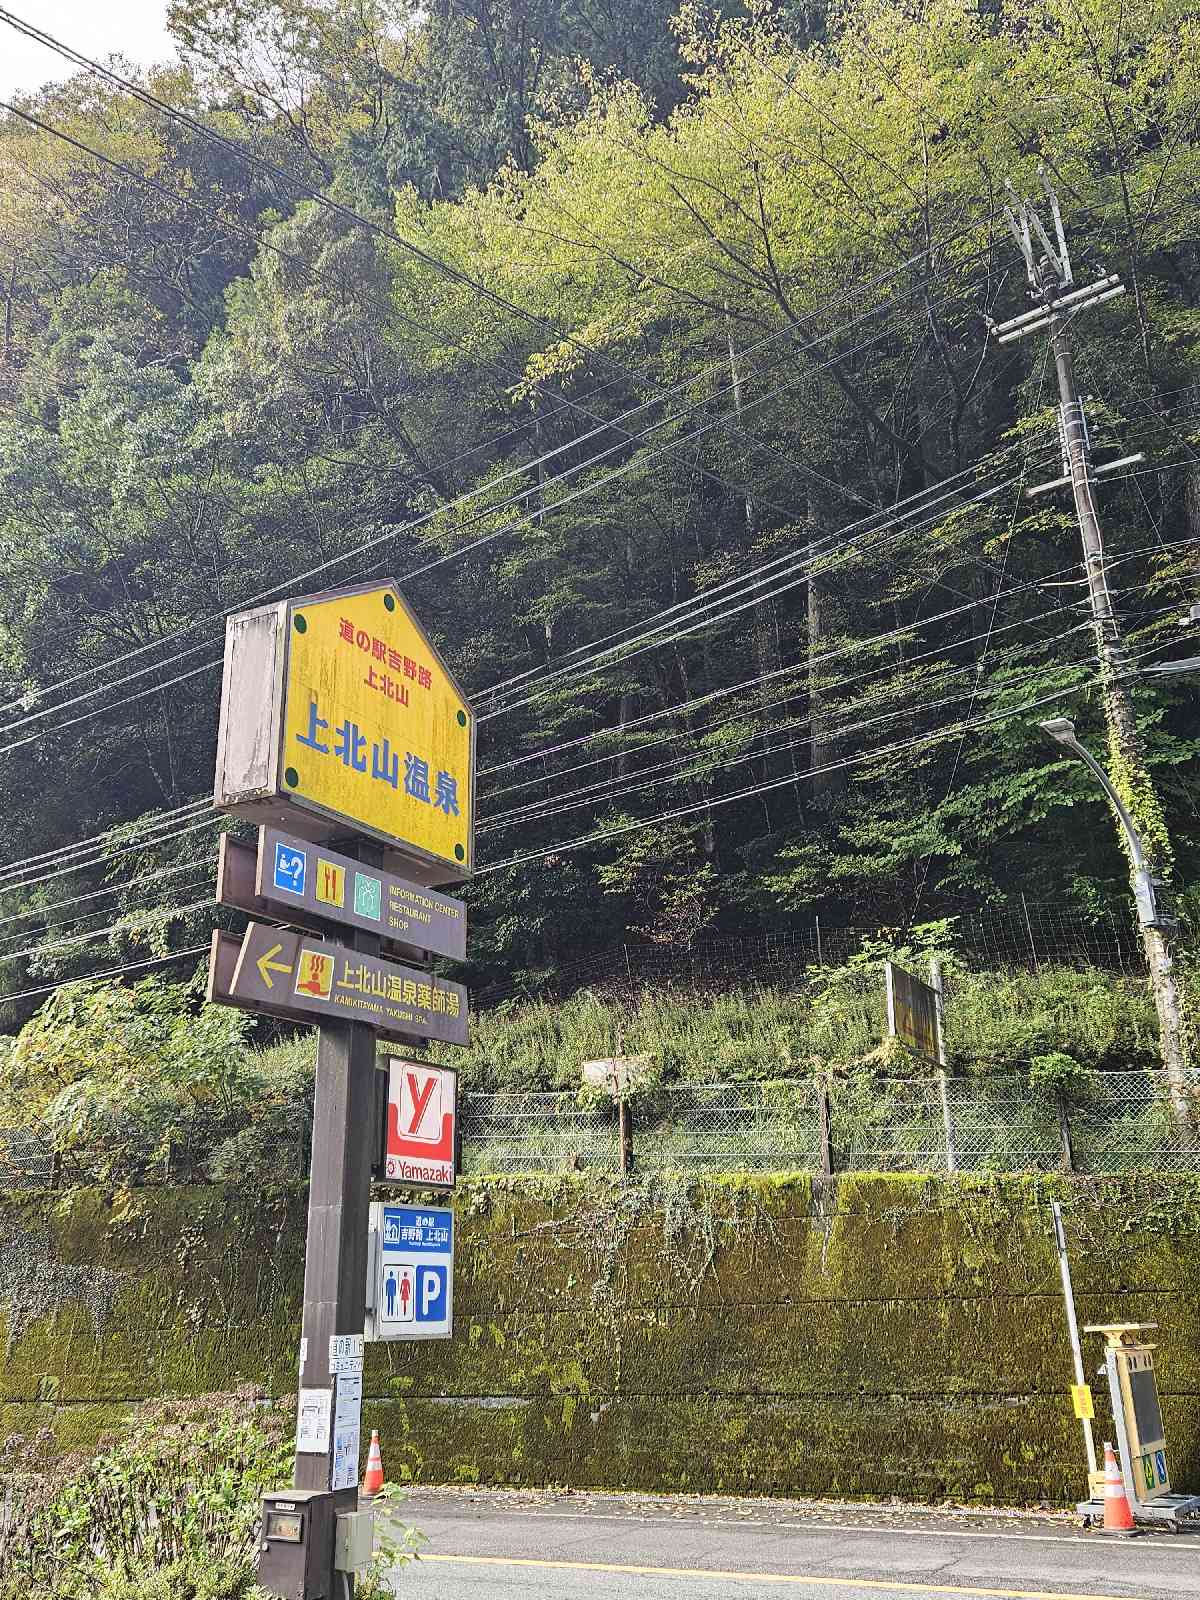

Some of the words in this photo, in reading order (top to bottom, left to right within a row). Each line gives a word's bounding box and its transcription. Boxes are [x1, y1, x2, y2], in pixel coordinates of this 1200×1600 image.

[339, 617, 432, 690] 道の駅吉野路
[364, 665, 409, 708] 上北山
[296, 702, 460, 817] 上北山温泉
[389, 885, 433, 909] INFORMATION
[434, 902, 460, 919] CENTER
[389, 900, 432, 924] RESTAURANT
[389, 916, 409, 931] SHOP
[334, 994, 384, 1014] KAMIKITAYAMA
[336, 959, 460, 1019] 上北山温泉薬師湯
[400, 1160, 453, 1183] Yamazaki
[425, 1229, 449, 1242] 上北山
[422, 1271, 441, 1316] P
